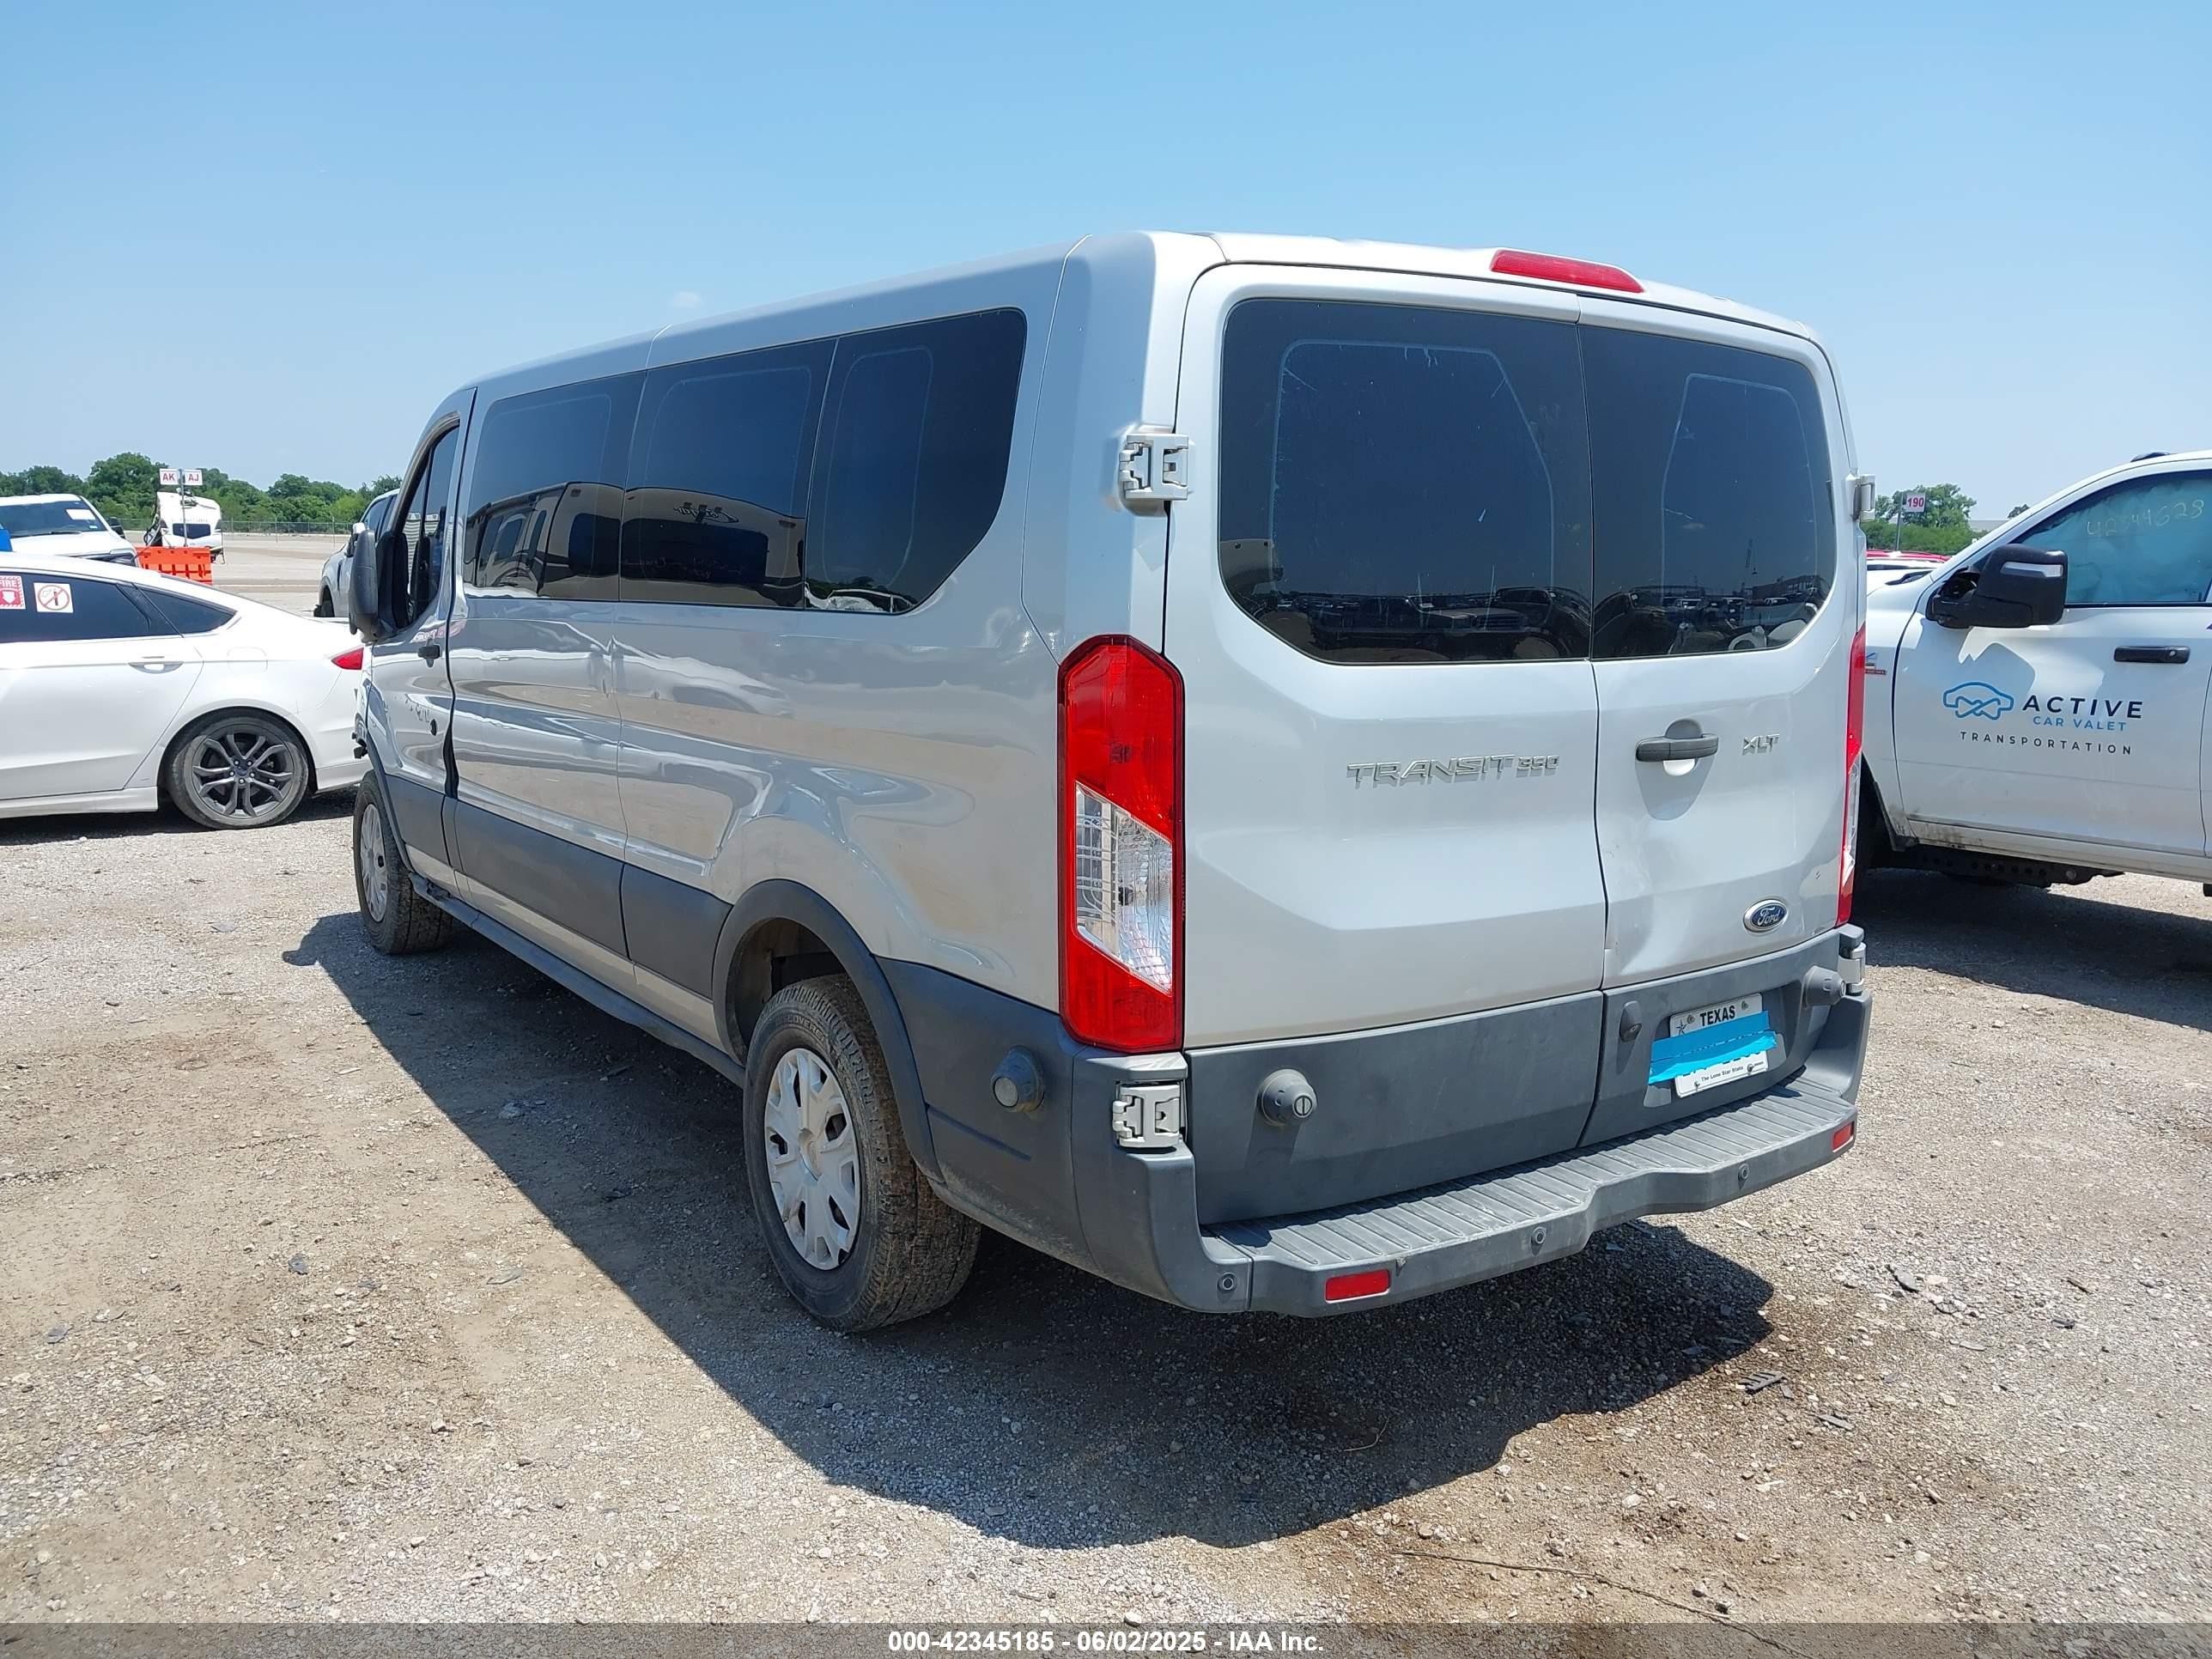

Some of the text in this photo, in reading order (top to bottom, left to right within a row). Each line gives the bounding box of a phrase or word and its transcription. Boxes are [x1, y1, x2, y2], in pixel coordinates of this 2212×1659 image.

[162, 473, 175, 482] AK
[188, 473, 199, 482] AJ
[1907, 497, 1924, 507] 190
[2022, 695, 2143, 719] ACTIVE
[2033, 715, 2127, 732] CAR VALET
[1743, 733, 1780, 750] XLT
[1960, 732, 2132, 755] TRANSPORTATION
[1346, 754, 1560, 782] TRANSIT 350
[1757, 906, 1781, 926] Ford
[1699, 1005, 1735, 1026] TEXAS
